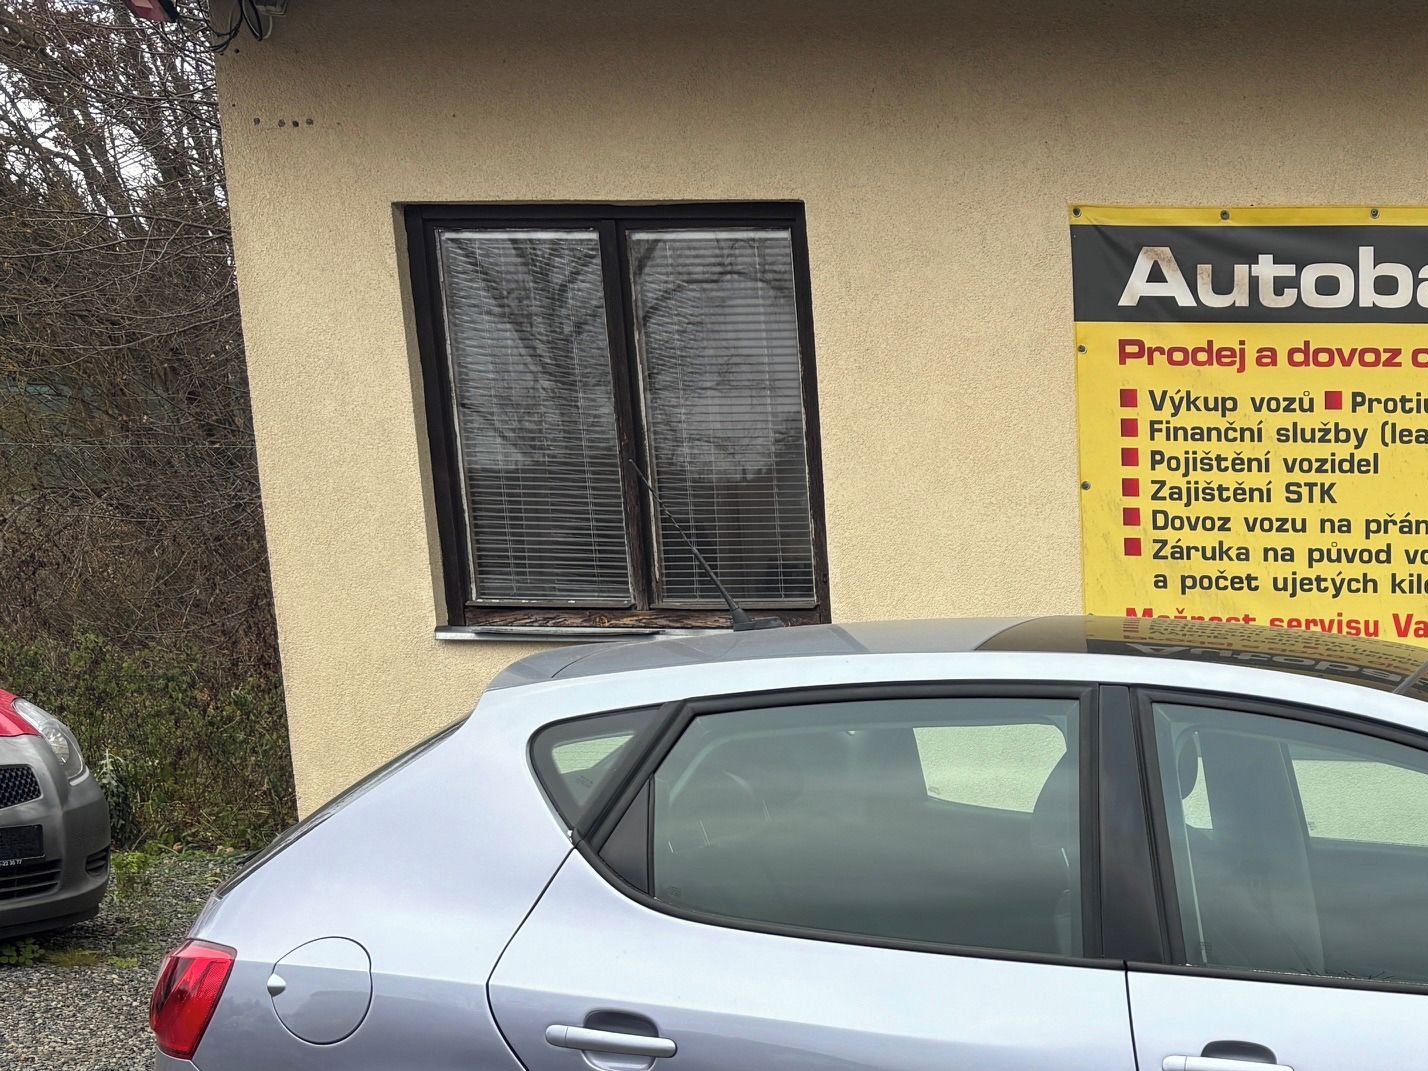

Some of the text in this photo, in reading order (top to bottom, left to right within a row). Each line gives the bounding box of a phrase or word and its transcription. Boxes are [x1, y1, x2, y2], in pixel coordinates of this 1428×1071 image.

[1118, 339, 1246, 373] Prodej
[1255, 347, 1278, 368] a
[1287, 341, 1402, 369] dovoz
[1148, 389, 1238, 417] Výkup
[1250, 390, 1314, 413] vozů
[1149, 420, 1263, 443] Finanční
[1276, 421, 1368, 450] služby
[1150, 450, 1379, 477] Pojištění vozidel
[1150, 480, 1338, 507] Zajištění STK
[1152, 509, 1232, 532] Dovoz
[1244, 516, 1307, 533] vozu
[1320, 517, 1352, 534] na
[1152, 538, 1250, 562] Záruka
[1263, 546, 1295, 562] na
[1307, 542, 1392, 569] původ
[1153, 573, 1168, 589] a
[1180, 569, 1260, 595] počet
[1272, 570, 1378, 599] ujetých
